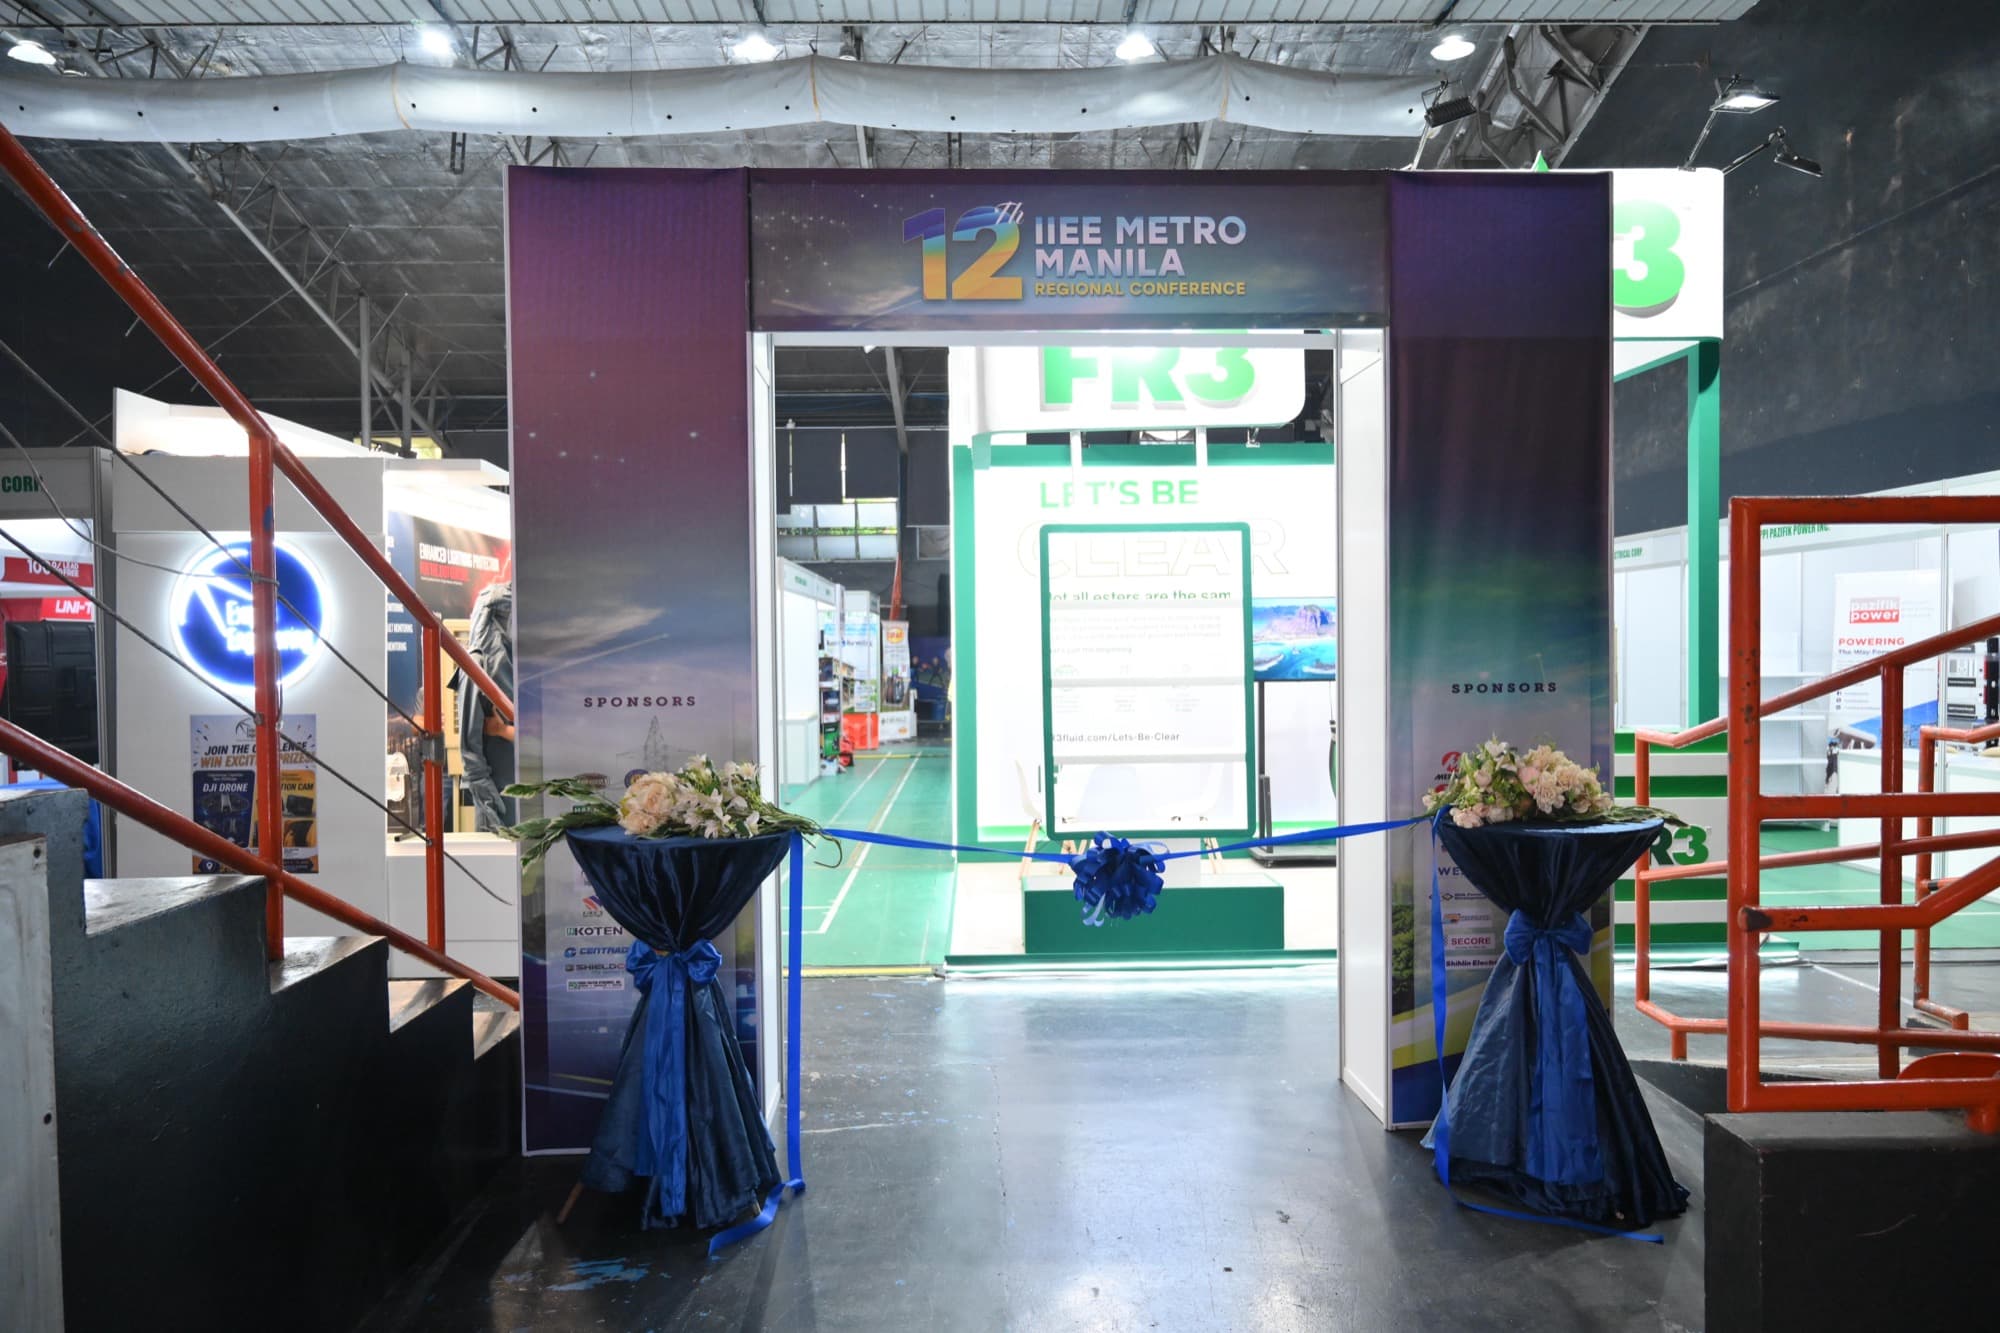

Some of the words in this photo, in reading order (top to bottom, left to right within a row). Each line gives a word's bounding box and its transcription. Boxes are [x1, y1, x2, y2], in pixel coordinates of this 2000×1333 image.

[1035, 216, 1103, 245] IIEE
[1116, 215, 1247, 246] METRO
[903, 206, 1023, 300] 12
[1035, 249, 1185, 277] MANILA
[1035, 283, 1124, 296] REGIONAL
[1130, 282, 1247, 297] CONFERENCE
[1040, 338, 1257, 409] FR3
[1151, 480, 1199, 505] BE
[1851, 610, 1898, 620] power
[1838, 637, 1904, 646] POWERING
[1853, 648, 1870, 656] Way
[1451, 683, 1557, 694] SPONSORS
[584, 696, 695, 707] SPONSORS
[204, 746, 229, 755] JOIN
[231, 745, 250, 753] THE
[201, 757, 221, 768] WIN
[203, 784, 217, 792] DJI
[219, 783, 248, 792] DRONE
[575, 927, 623, 936] KOTEN
[1451, 937, 1491, 945] SECORE
